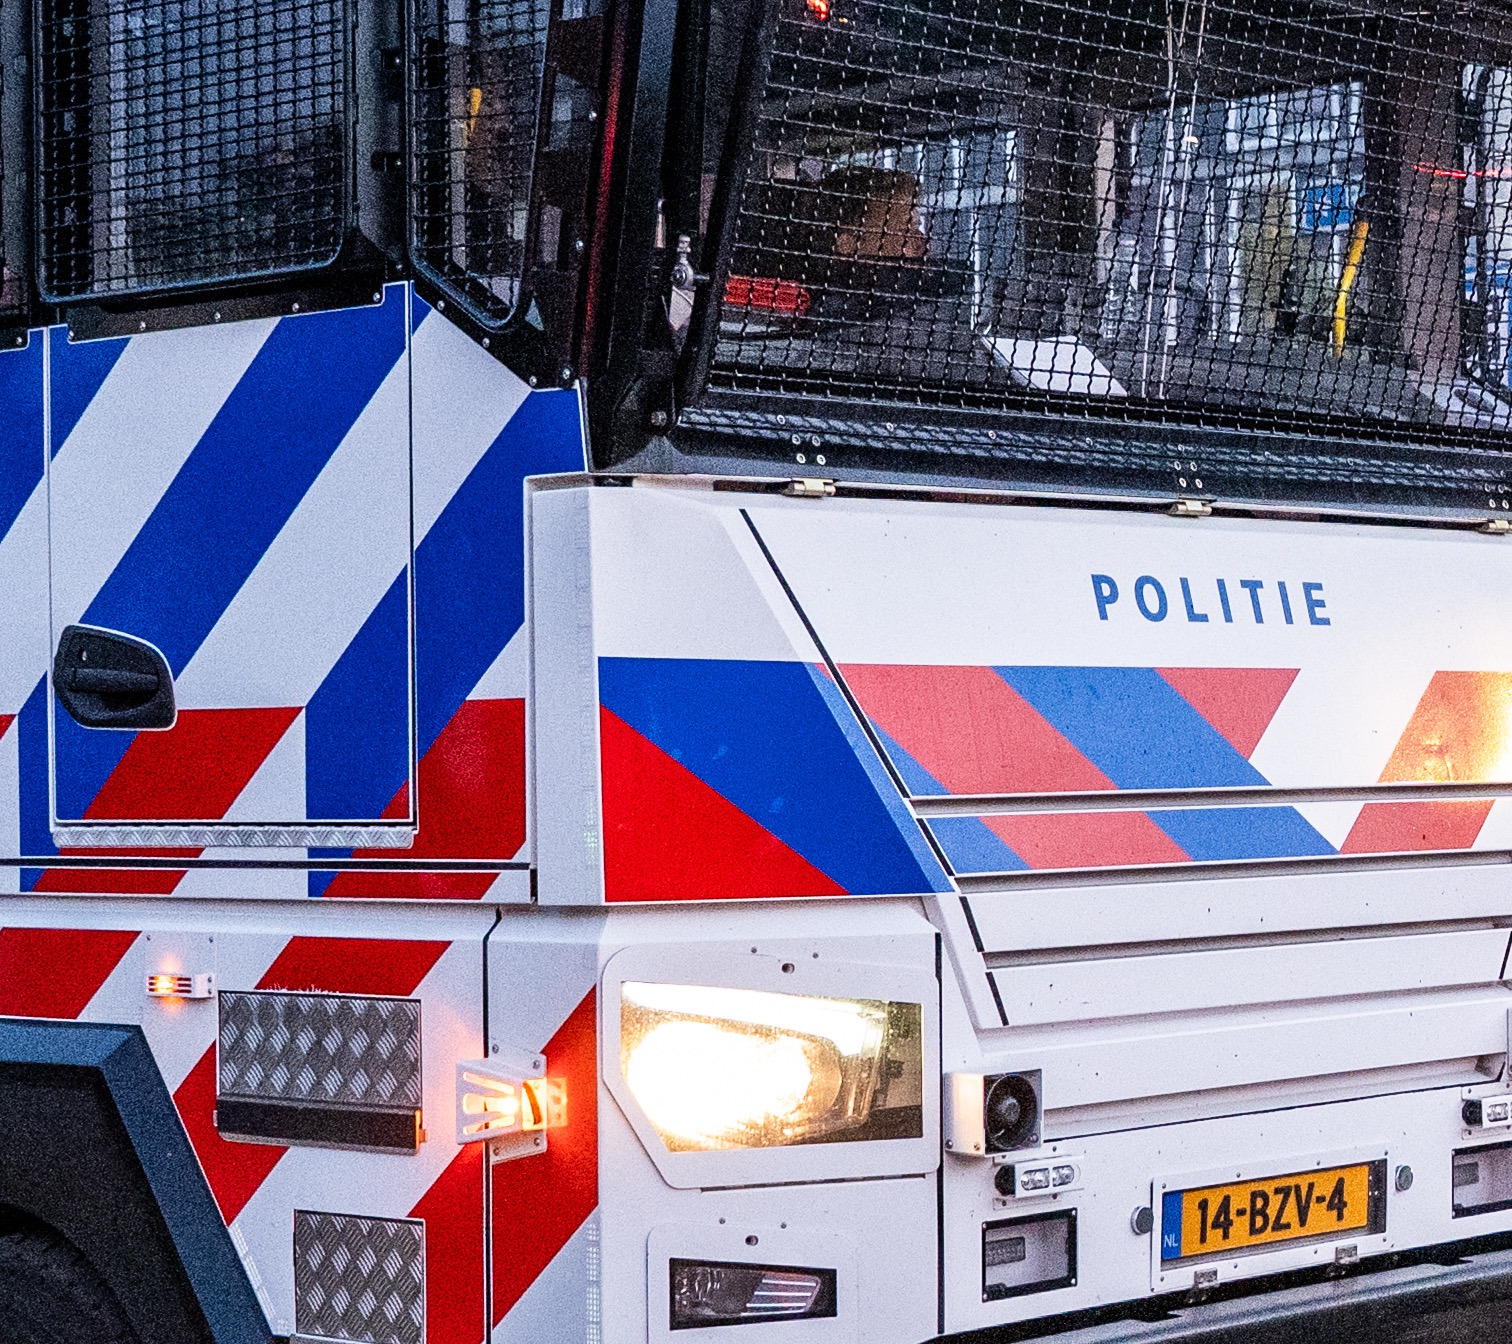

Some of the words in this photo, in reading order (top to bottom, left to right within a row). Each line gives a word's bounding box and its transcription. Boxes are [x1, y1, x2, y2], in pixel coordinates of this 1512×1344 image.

[1092, 573, 1332, 626] POLITIE
[1163, 1232, 1179, 1248] NL
[1197, 1176, 1348, 1244] 14-BZV-4
